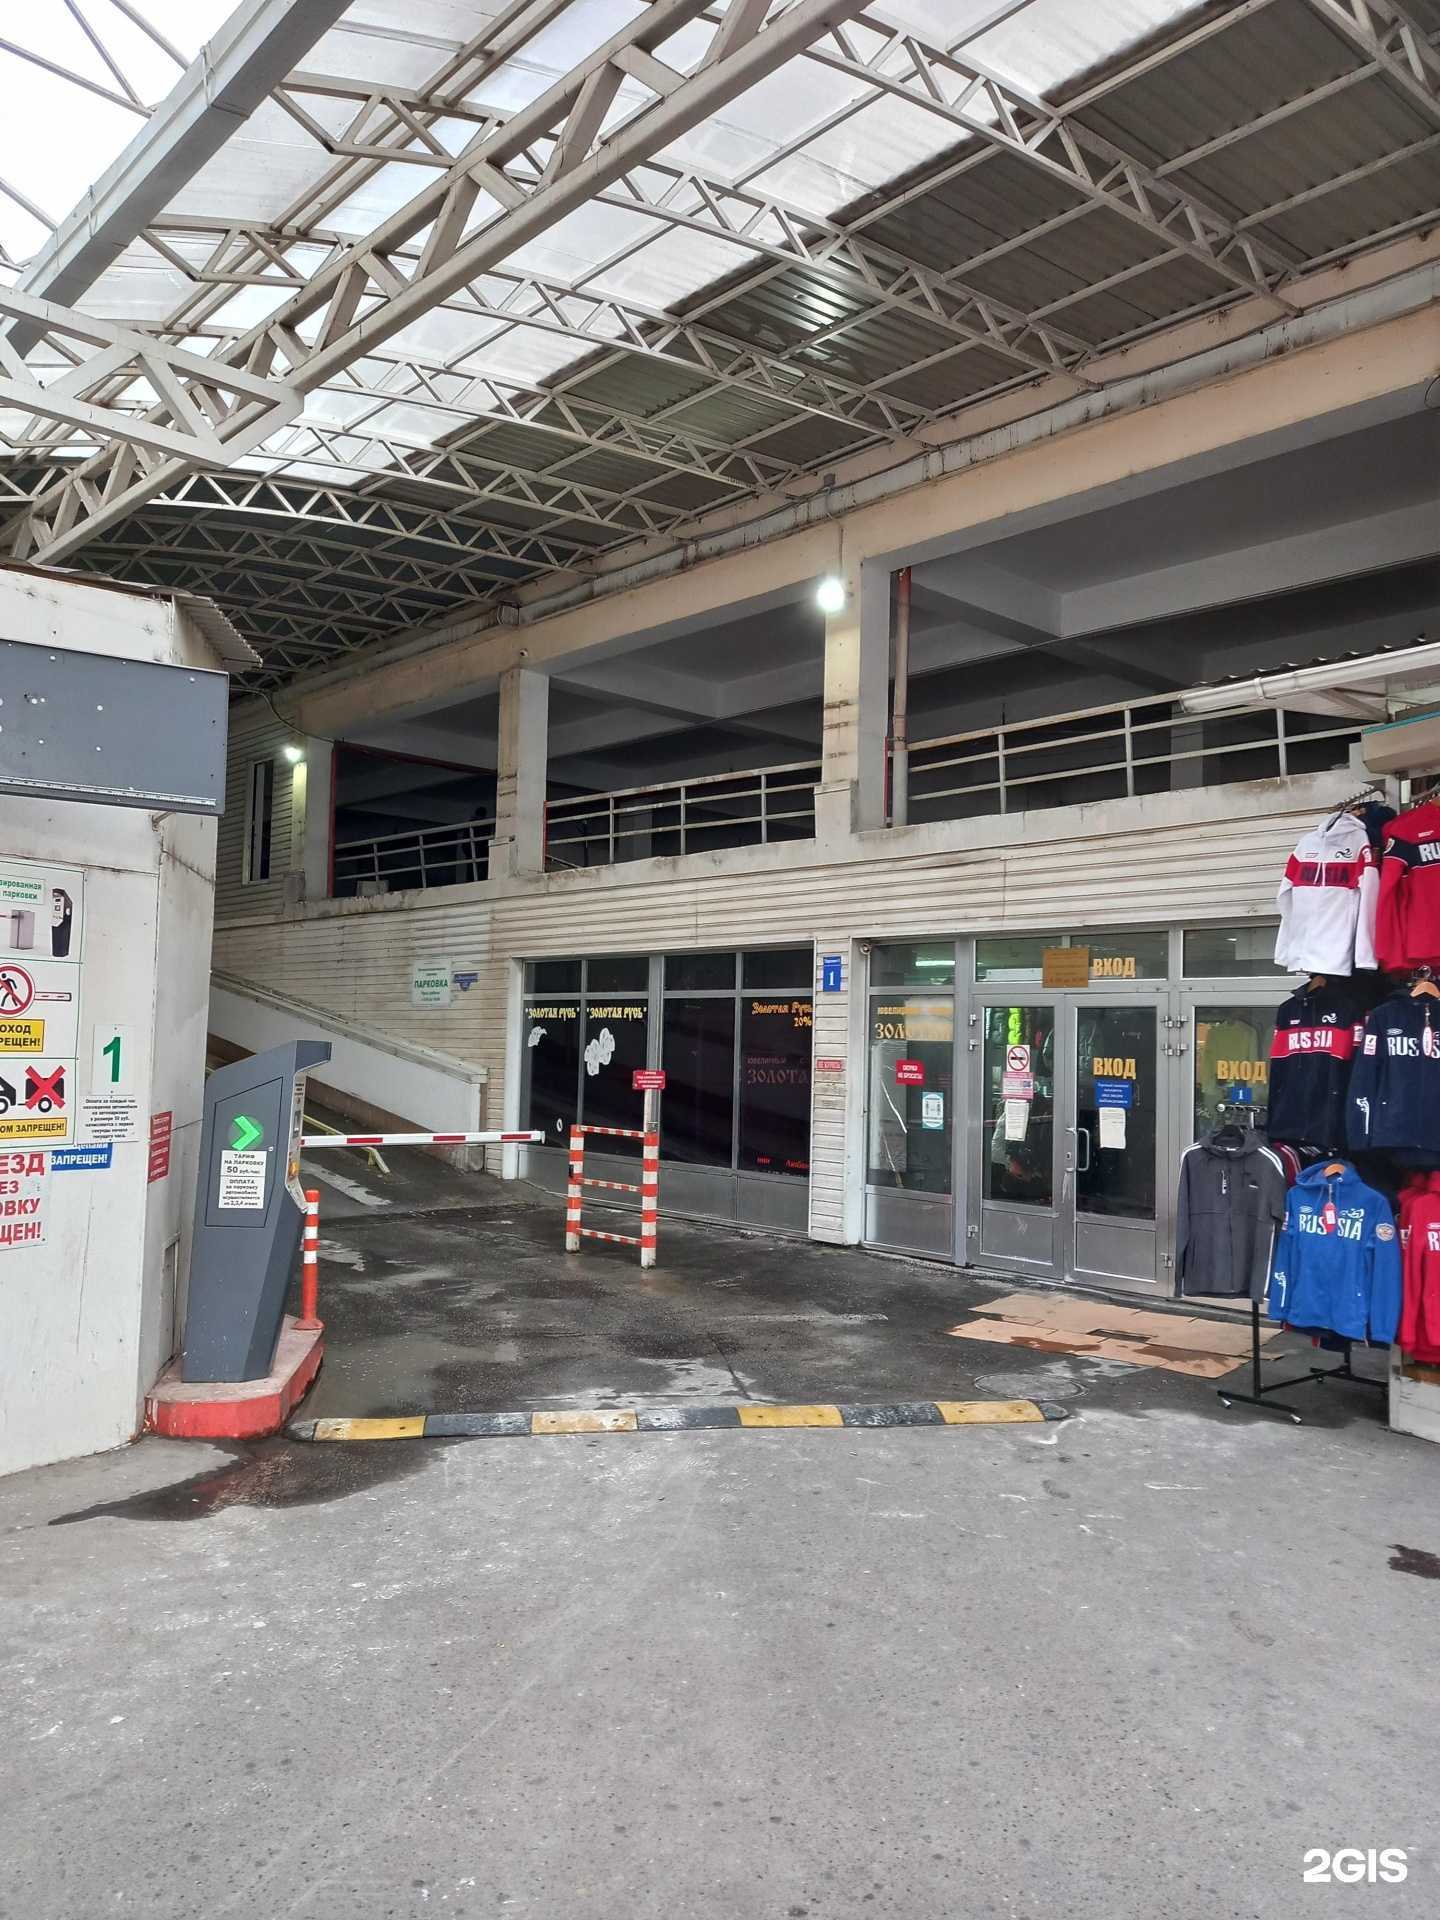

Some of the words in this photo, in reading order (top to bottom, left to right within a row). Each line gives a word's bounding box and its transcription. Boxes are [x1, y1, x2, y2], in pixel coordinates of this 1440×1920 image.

[1093, 957, 1136, 979] ВХОД
[414, 979, 449, 988] ПАРКОВКА
[828, 970, 836, 986] 1
[793, 1016, 812, 1027] 20%
[102, 1036, 121, 1083] 1
[1093, 1057, 1137, 1080] ВХОД
[1217, 1060, 1267, 1084] ВХОД
[1238, 1089, 1244, 1100] 1
[16, 1122, 65, 1133] ЗАПРЕЩЕН!
[50, 1153, 108, 1166] ЗАПРЕЩЕН!
[226, 1165, 239, 1174] 50
